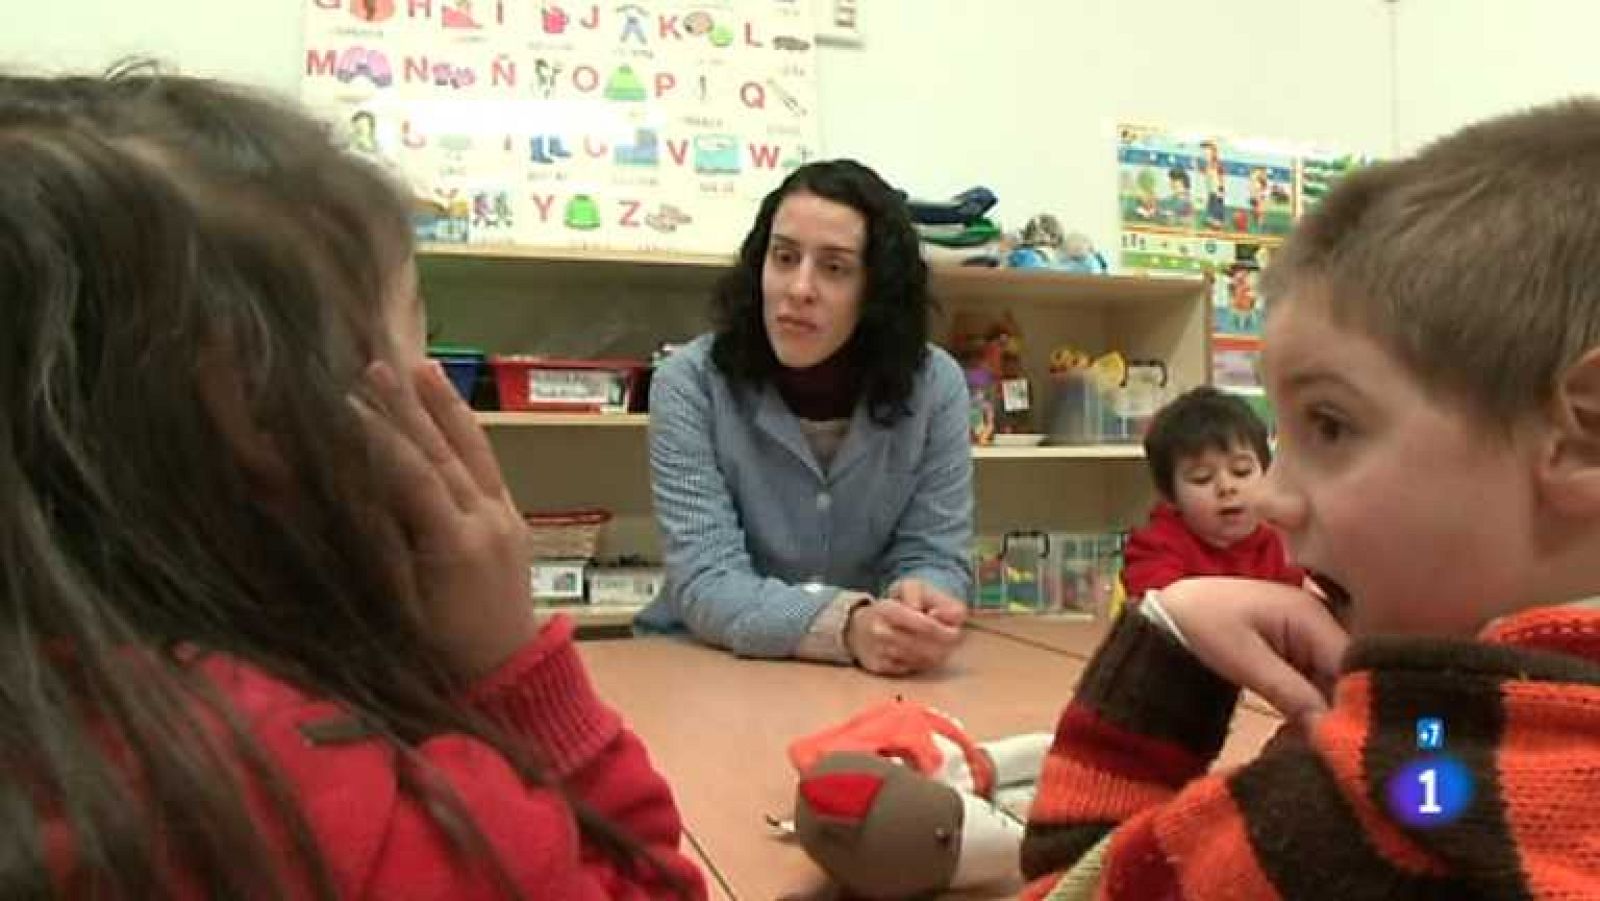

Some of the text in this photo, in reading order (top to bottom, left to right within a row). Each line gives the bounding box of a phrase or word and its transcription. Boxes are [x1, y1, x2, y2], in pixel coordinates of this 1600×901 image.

[580, 4, 600, 30] J
[658, 14, 684, 41] K
[744, 21, 764, 48] L
[306, 49, 766, 110] M N Ñ O P Q
[666, 138, 689, 167] V
[748, 141, 781, 171] W
[532, 193, 641, 228] Y Z
